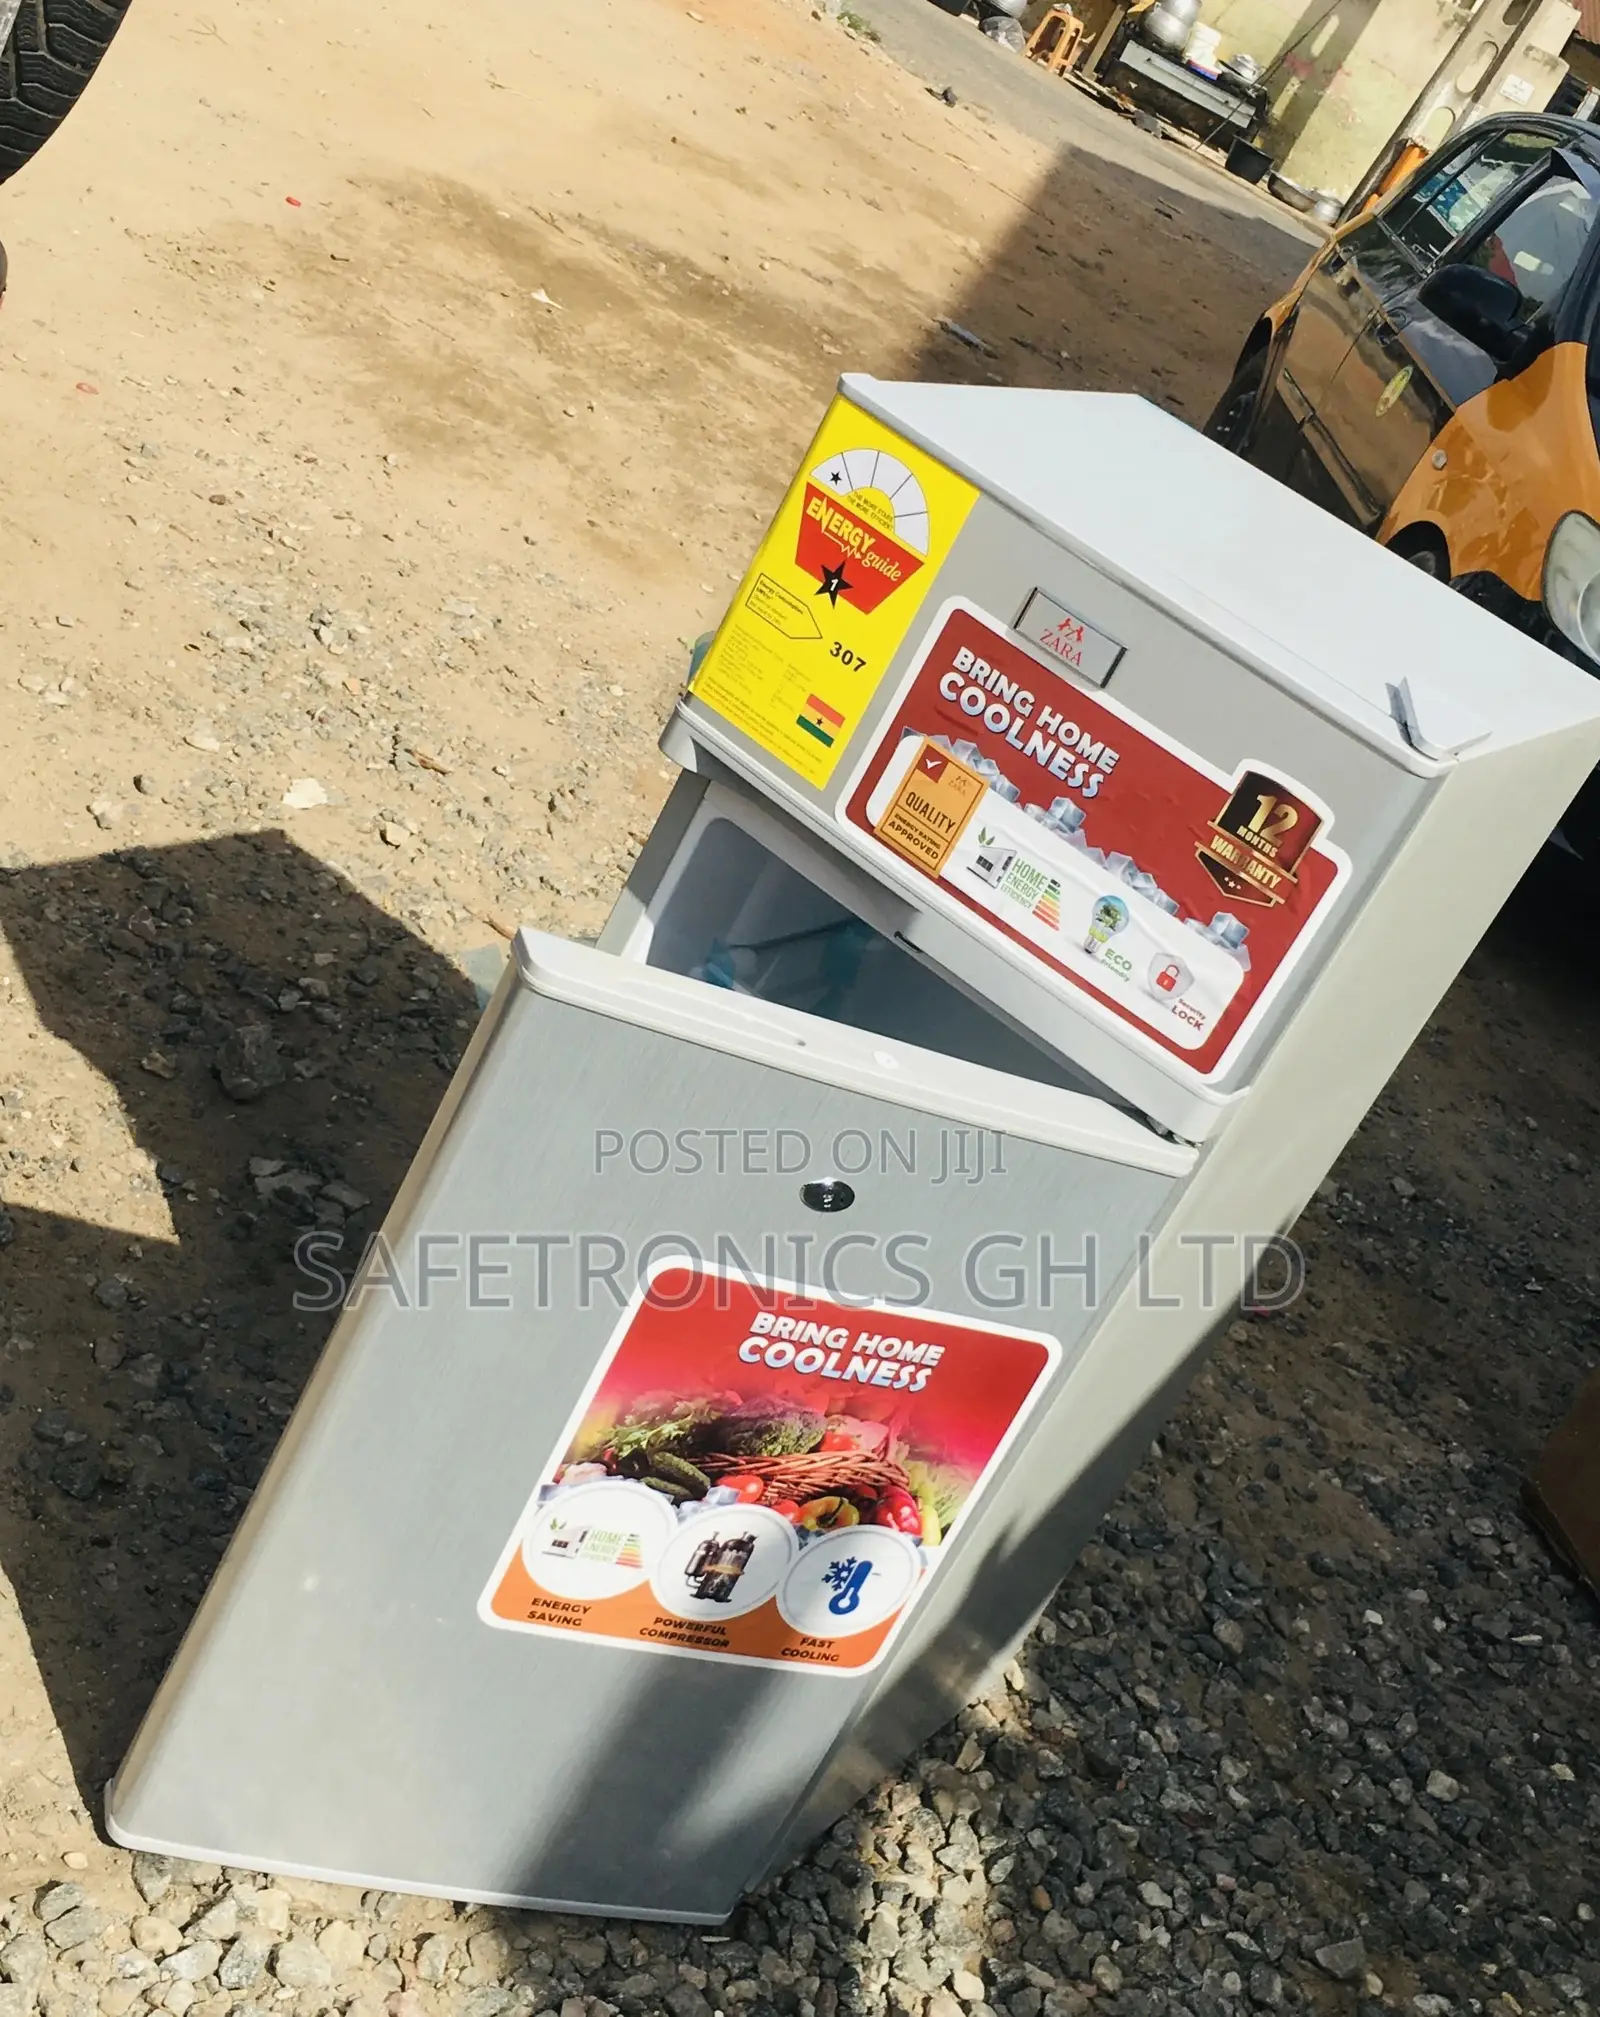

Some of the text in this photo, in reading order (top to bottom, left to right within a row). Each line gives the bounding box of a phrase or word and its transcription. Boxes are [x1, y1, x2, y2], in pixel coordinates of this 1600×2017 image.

[806, 496, 876, 553] ENERGY
[862, 551, 901, 581] guide
[830, 579, 838, 591] 1
[830, 641, 867, 672] 307
[1039, 628, 1083, 667] ZARA
[952, 646, 1120, 775] BRING HOME
[939, 671, 1104, 799] COOLNESS
[905, 791, 956, 834] QUALITY
[1247, 794, 1298, 848] 12
[888, 821, 939, 860] APPROVED
[894, 813, 942, 850] ENERGY RATING
[1236, 825, 1278, 858] MONTHS
[1012, 858, 1048, 891] HOME
[1210, 834, 1282, 889] WARRANTY
[1005, 873, 1040, 900] ENERGY
[1104, 948, 1133, 972] ECO
[1171, 1005, 1204, 1032] LOCK
[749, 1311, 946, 1367] BRING HOME
[738, 1335, 932, 1393] COOLNESS
[527, 1610, 583, 1627] SAVING
[531, 1597, 592, 1615] ENERGY
[639, 1627, 730, 1649] COMPRESSOR
[654, 1616, 727, 1636] POWERFUL
[800, 1636, 837, 1649] FAST
[781, 1647, 840, 1662] COOLING
